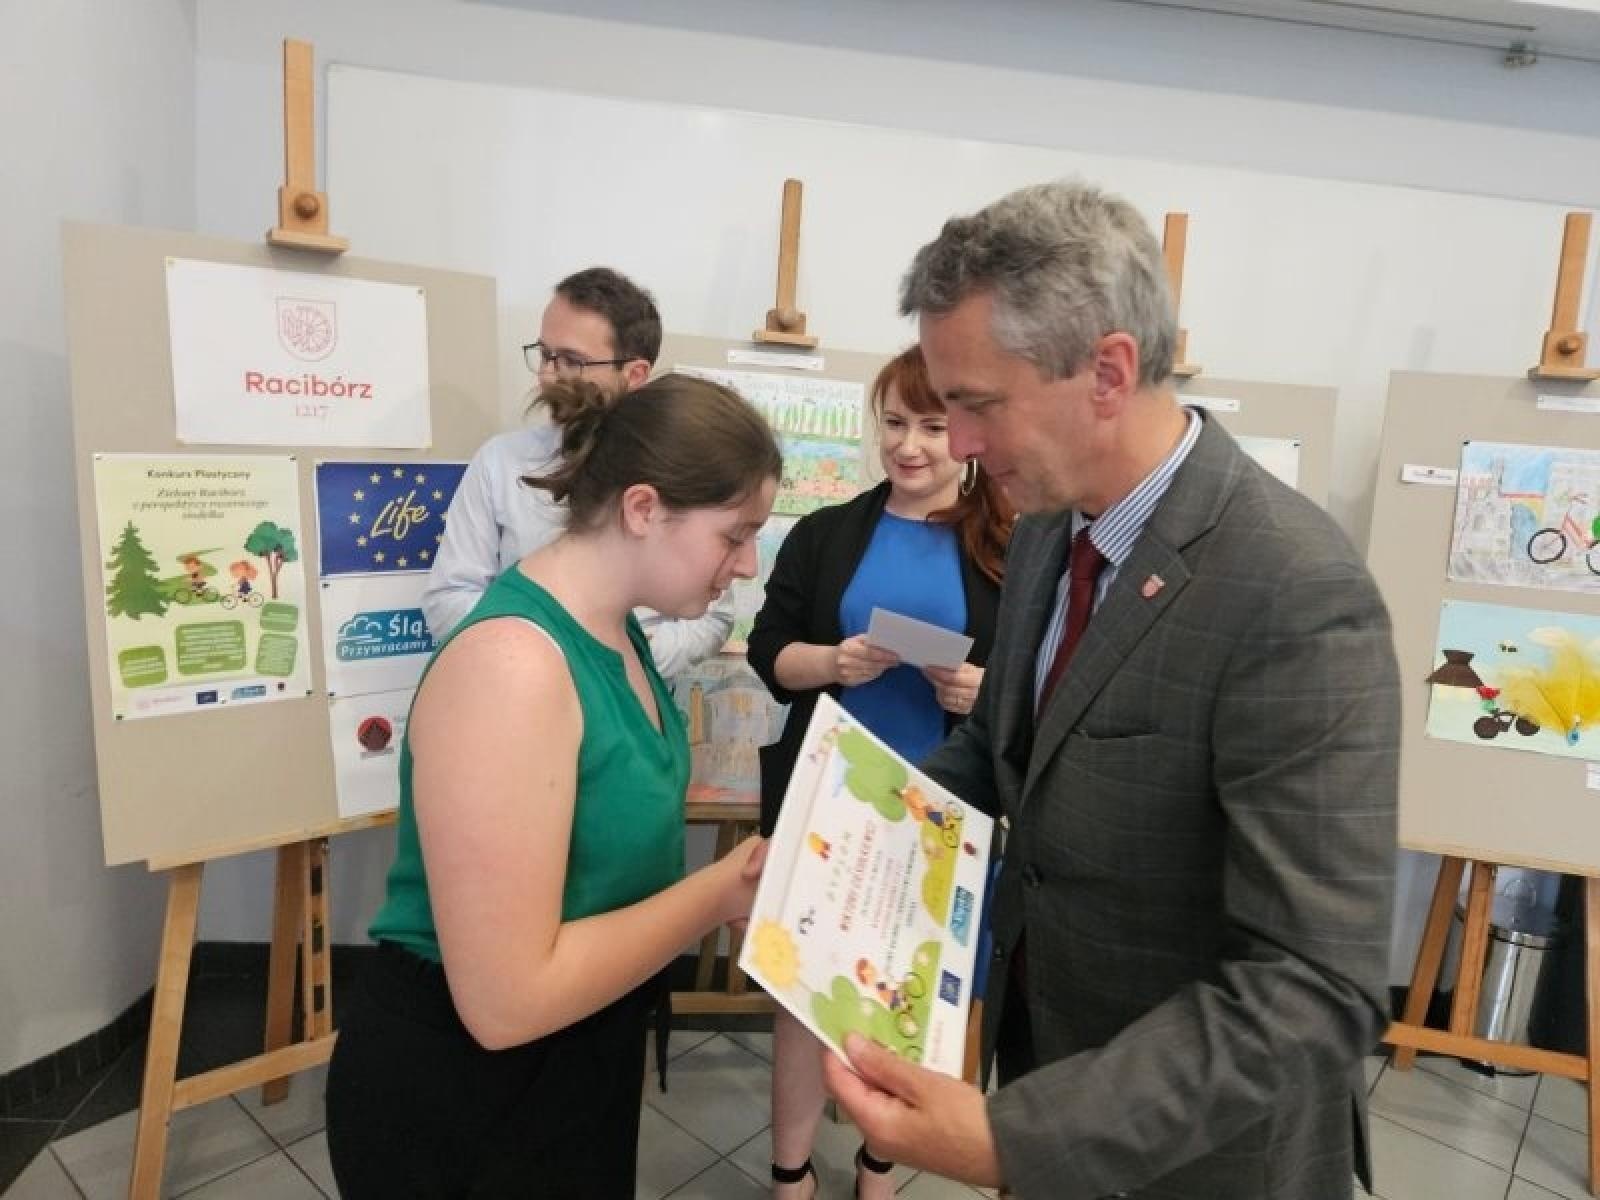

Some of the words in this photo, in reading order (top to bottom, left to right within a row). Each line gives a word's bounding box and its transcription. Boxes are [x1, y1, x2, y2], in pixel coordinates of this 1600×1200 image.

[245, 371, 373, 399] Racibórz
[294, 403, 331, 420] 1217
[370, 489, 430, 540] Life
